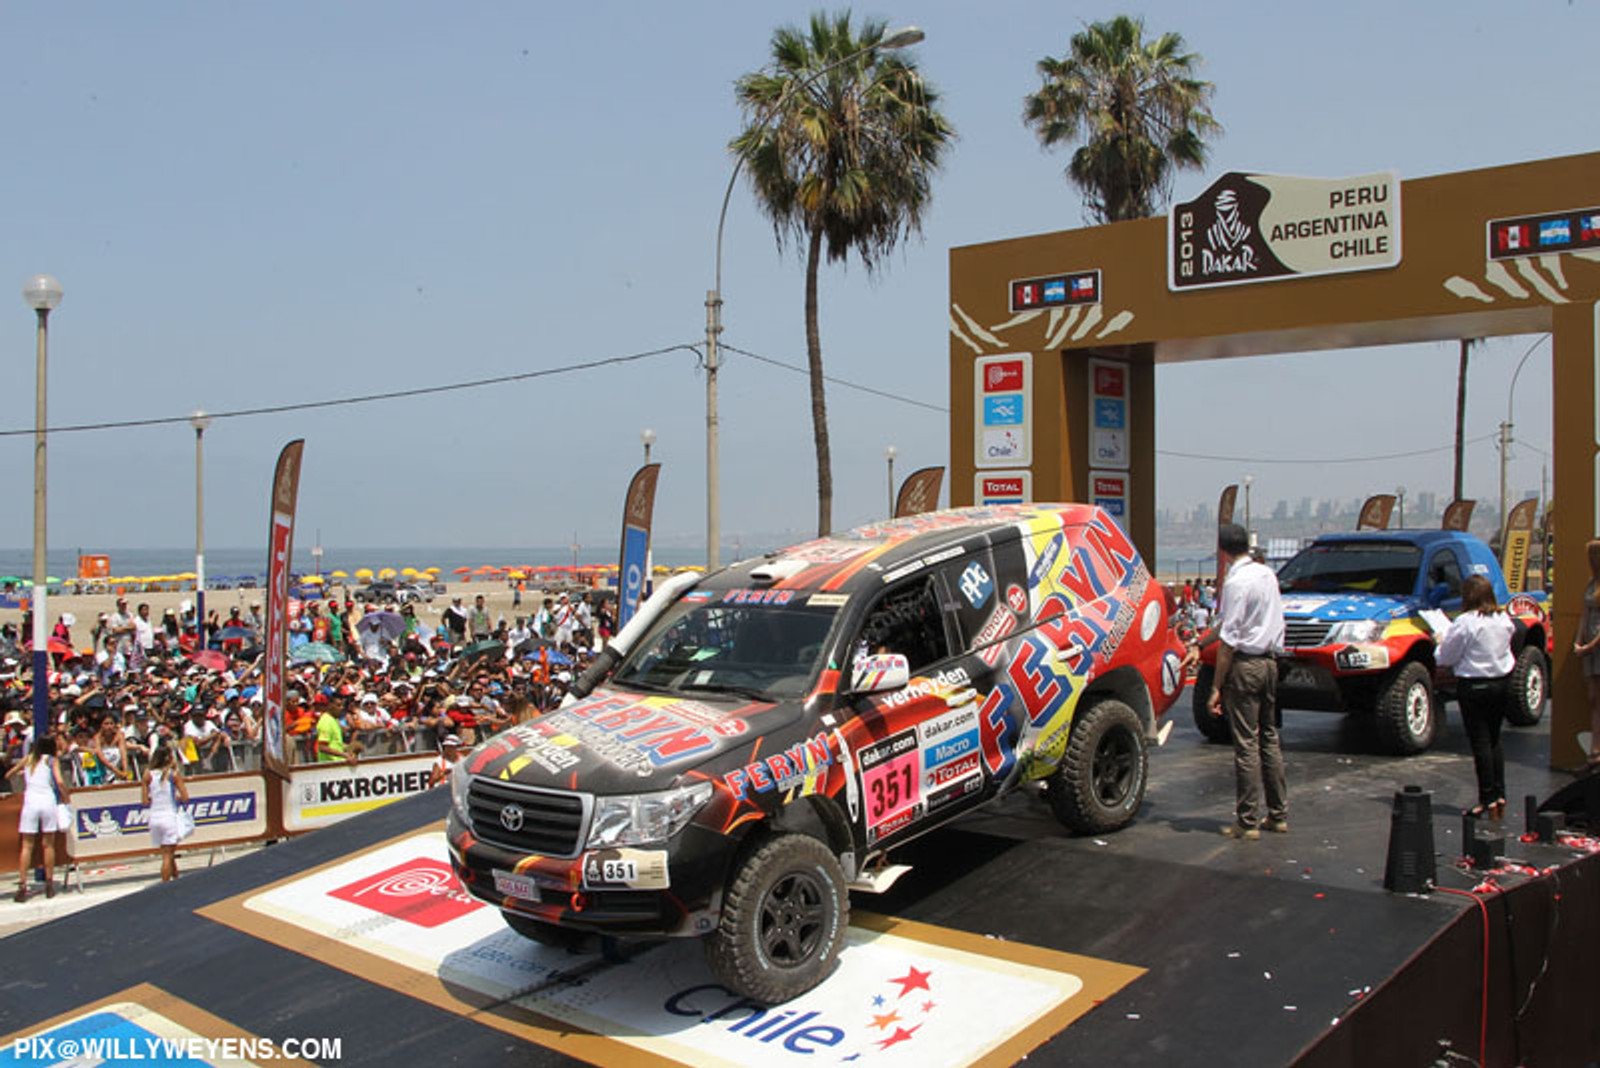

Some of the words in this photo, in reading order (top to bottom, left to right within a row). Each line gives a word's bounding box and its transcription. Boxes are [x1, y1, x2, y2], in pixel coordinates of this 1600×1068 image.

[1330, 184, 1388, 209] PERU
[1270, 211, 1388, 242] ARGENTINA
[1181, 212, 1193, 276] 2013
[1330, 236, 1388, 259] CHILE
[1202, 245, 1258, 275] DAKAR
[987, 482, 1020, 492] TOTAL
[1097, 482, 1121, 492] TOTAL
[978, 510, 1142, 777] FERYN
[882, 667, 969, 709] verheyden
[925, 712, 975, 738] dakar.com
[863, 735, 915, 765] dakar.com
[936, 738, 970, 762] Macro
[724, 732, 832, 801] FERYN
[939, 759, 976, 781] TOTAL
[320, 771, 432, 802] KÄRCHER
[871, 763, 912, 818] 351
[125, 798, 251, 825] MHELIN
[606, 863, 635, 879] 351
[664, 985, 845, 1053] Chile
